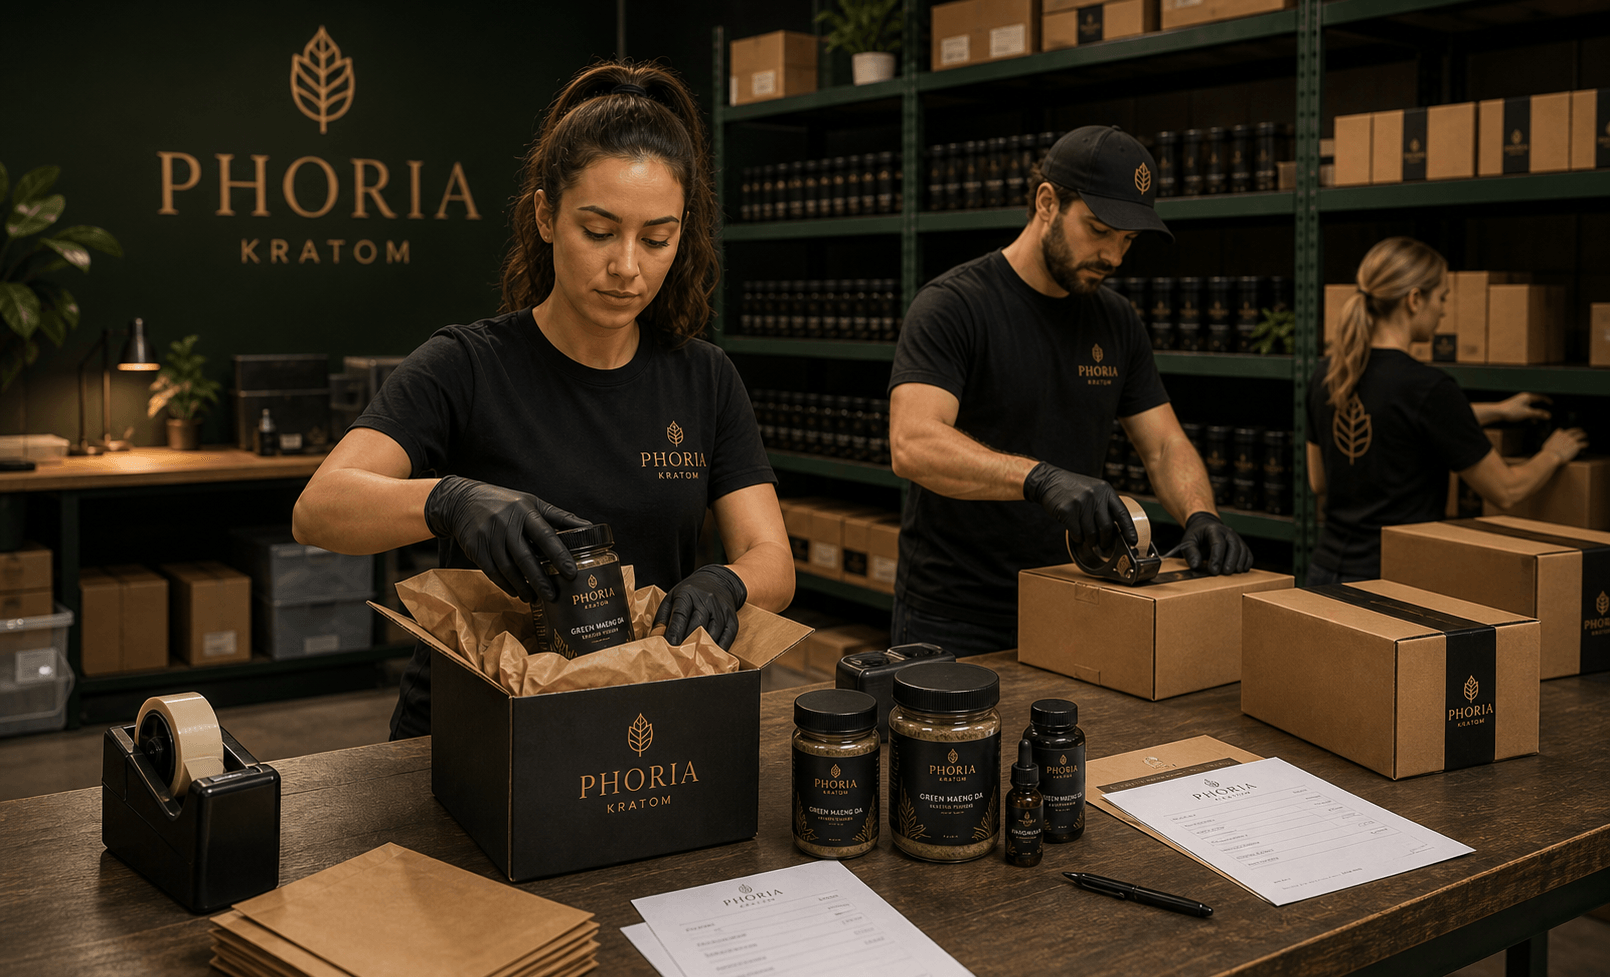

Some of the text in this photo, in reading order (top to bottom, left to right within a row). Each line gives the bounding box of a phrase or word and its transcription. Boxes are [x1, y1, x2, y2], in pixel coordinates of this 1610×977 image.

[156, 151, 483, 221] PHORIA
[240, 237, 411, 265] KRATOM
[1078, 365, 1119, 377] PHORIA
[640, 451, 707, 468] PHORIA
[658, 471, 699, 480] KRATOM
[572, 587, 615, 606] PHORIA
[570, 624, 596, 636] GREEN
[1448, 703, 1494, 721] PHORIA
[929, 764, 976, 776] PHORIA
[579, 760, 700, 800] PHORIA
[814, 778, 858, 790] PHORIA
[919, 792, 945, 803] GREEN
[1192, 783, 1258, 801] PHORIA
[607, 795, 671, 815] KRATOM
[723, 888, 784, 907] PHORIA
